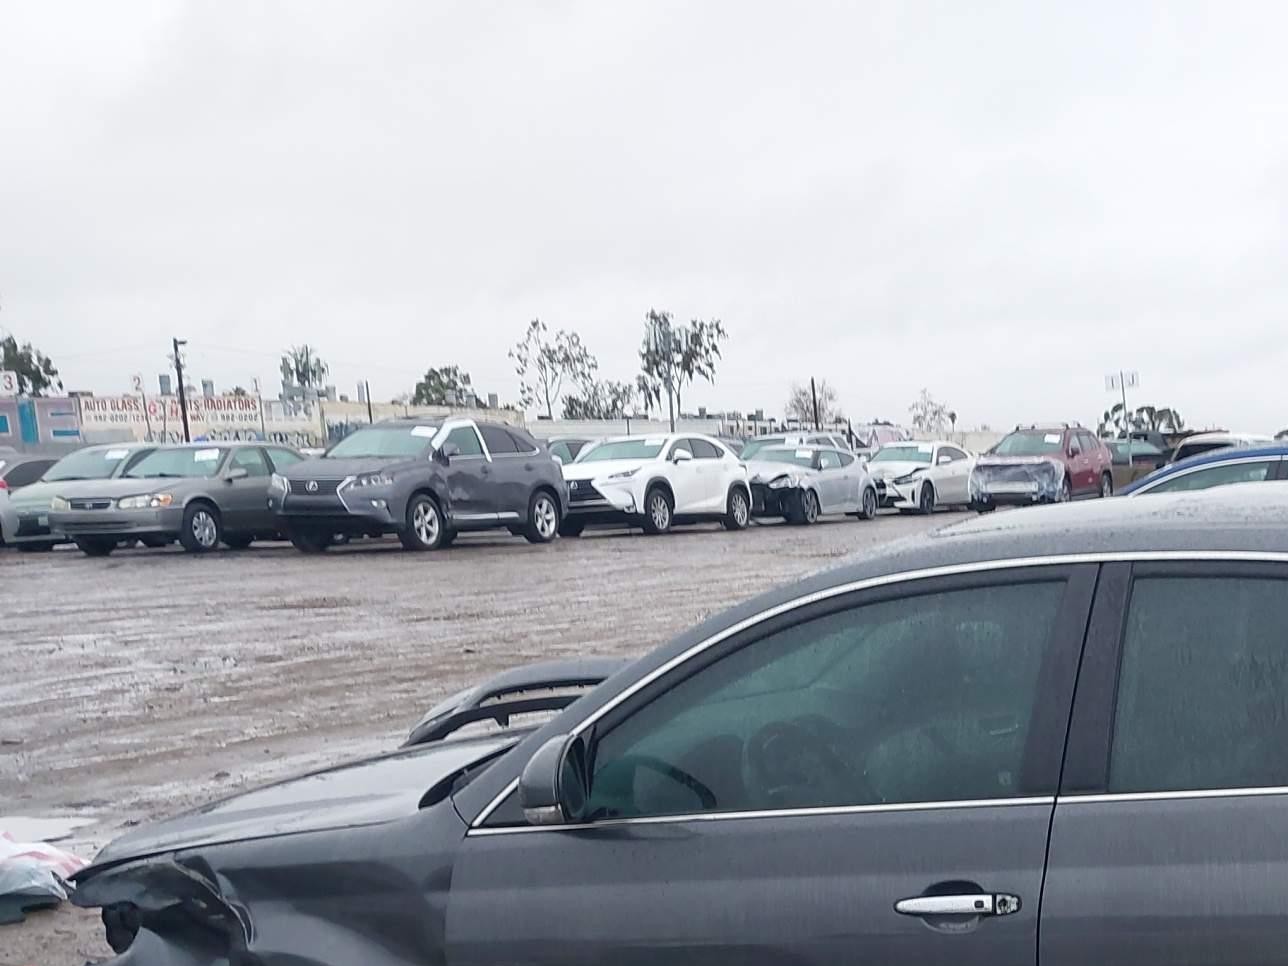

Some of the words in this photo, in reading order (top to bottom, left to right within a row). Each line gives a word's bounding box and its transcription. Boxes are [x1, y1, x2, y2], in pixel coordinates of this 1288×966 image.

[3, 374, 13, 391] 3
[133, 376, 141, 391] 2
[84, 400, 107, 411] AUTO
[110, 400, 140, 412] GLASS
